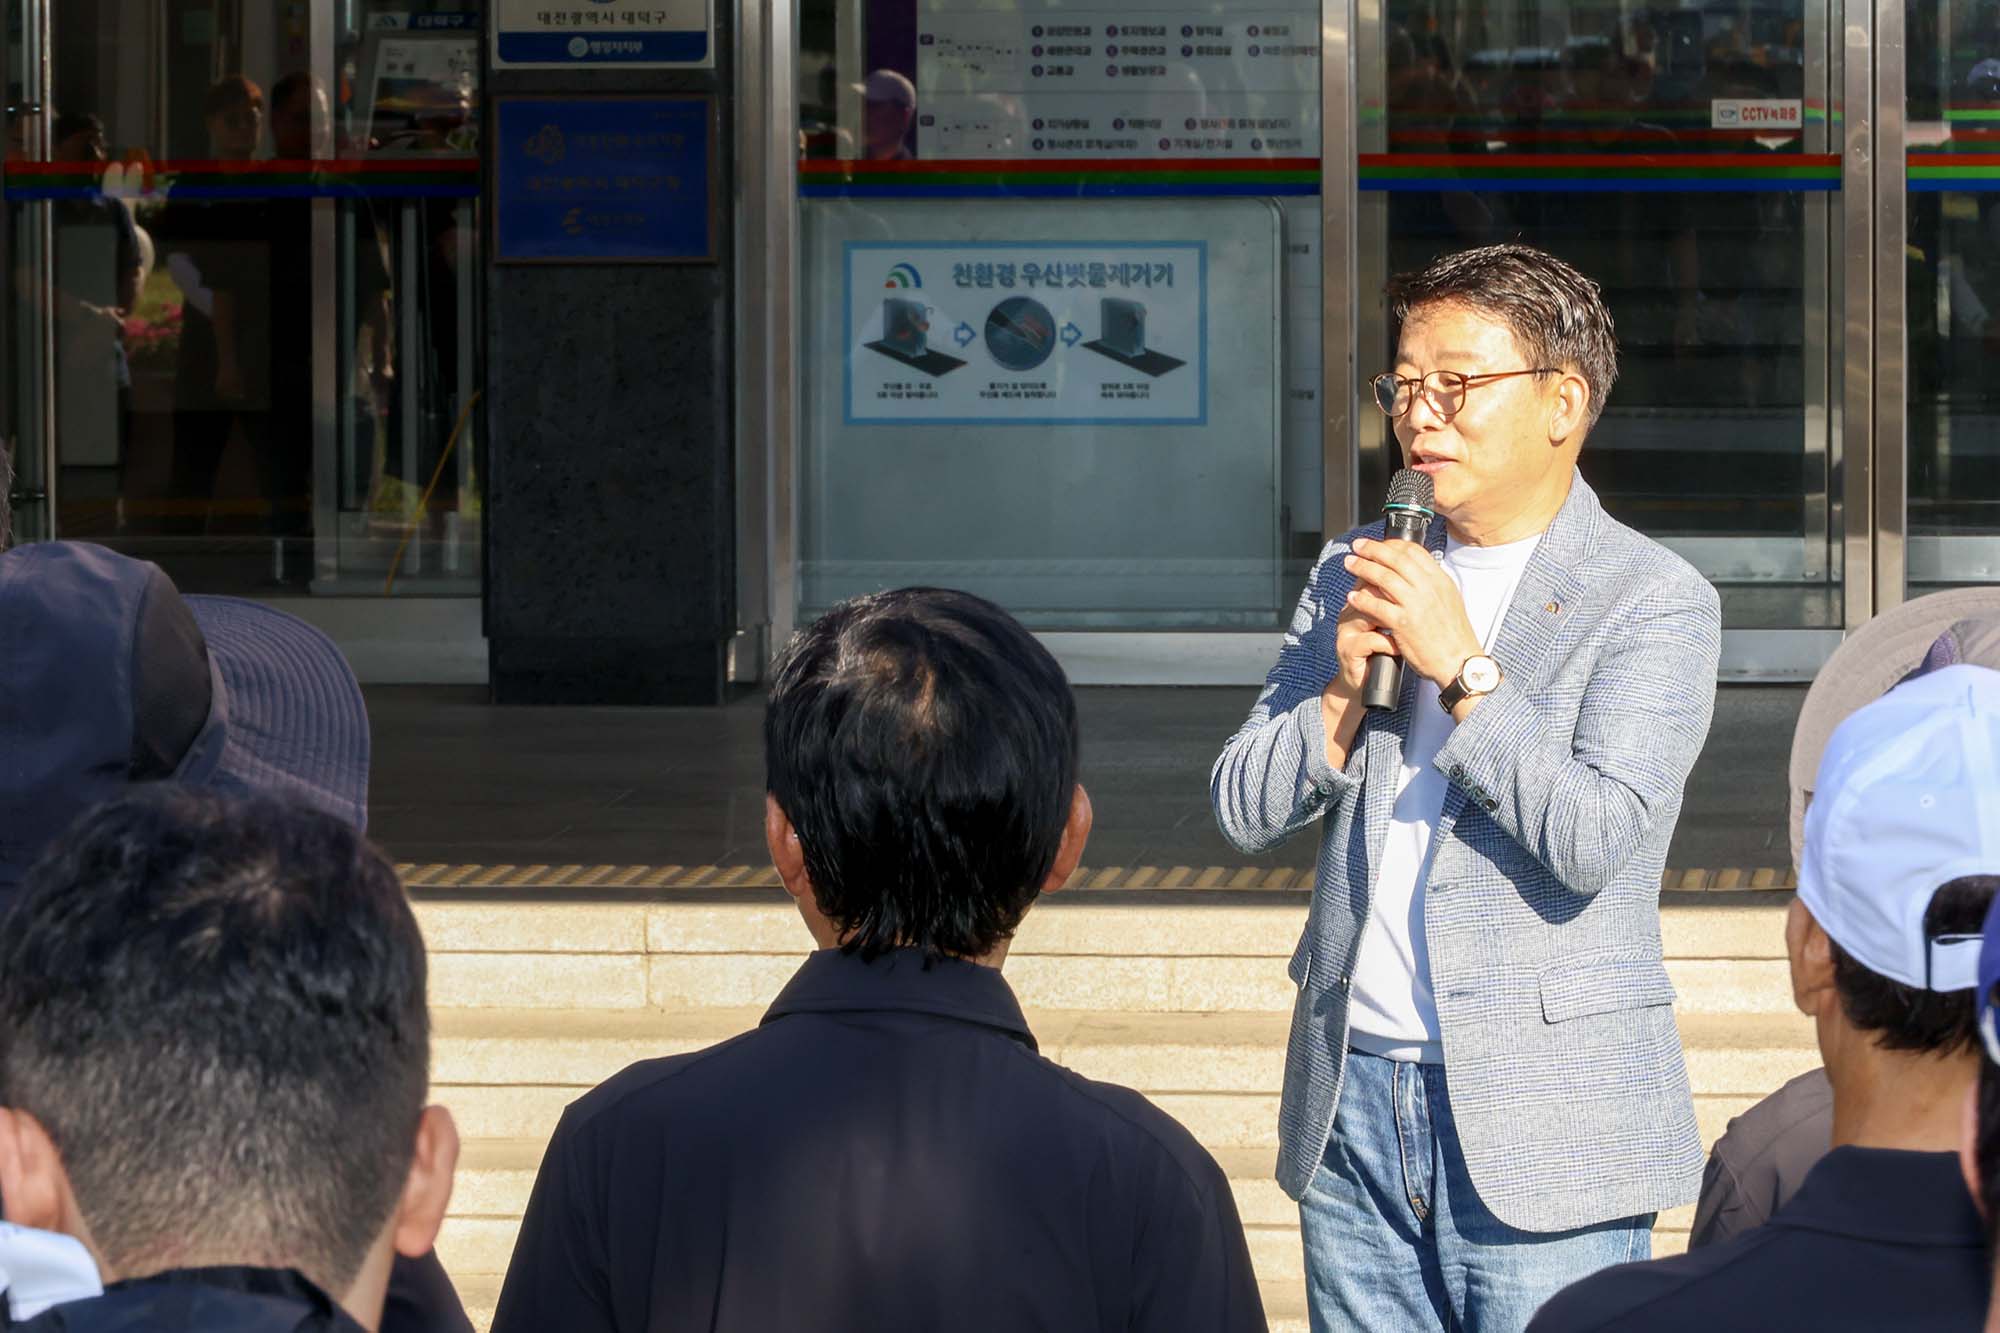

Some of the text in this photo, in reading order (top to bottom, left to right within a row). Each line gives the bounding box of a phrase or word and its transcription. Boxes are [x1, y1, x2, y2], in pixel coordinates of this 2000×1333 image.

[537, 11, 666, 25] 대전광역시 대덕구
[952, 261, 1017, 289] 친환경
